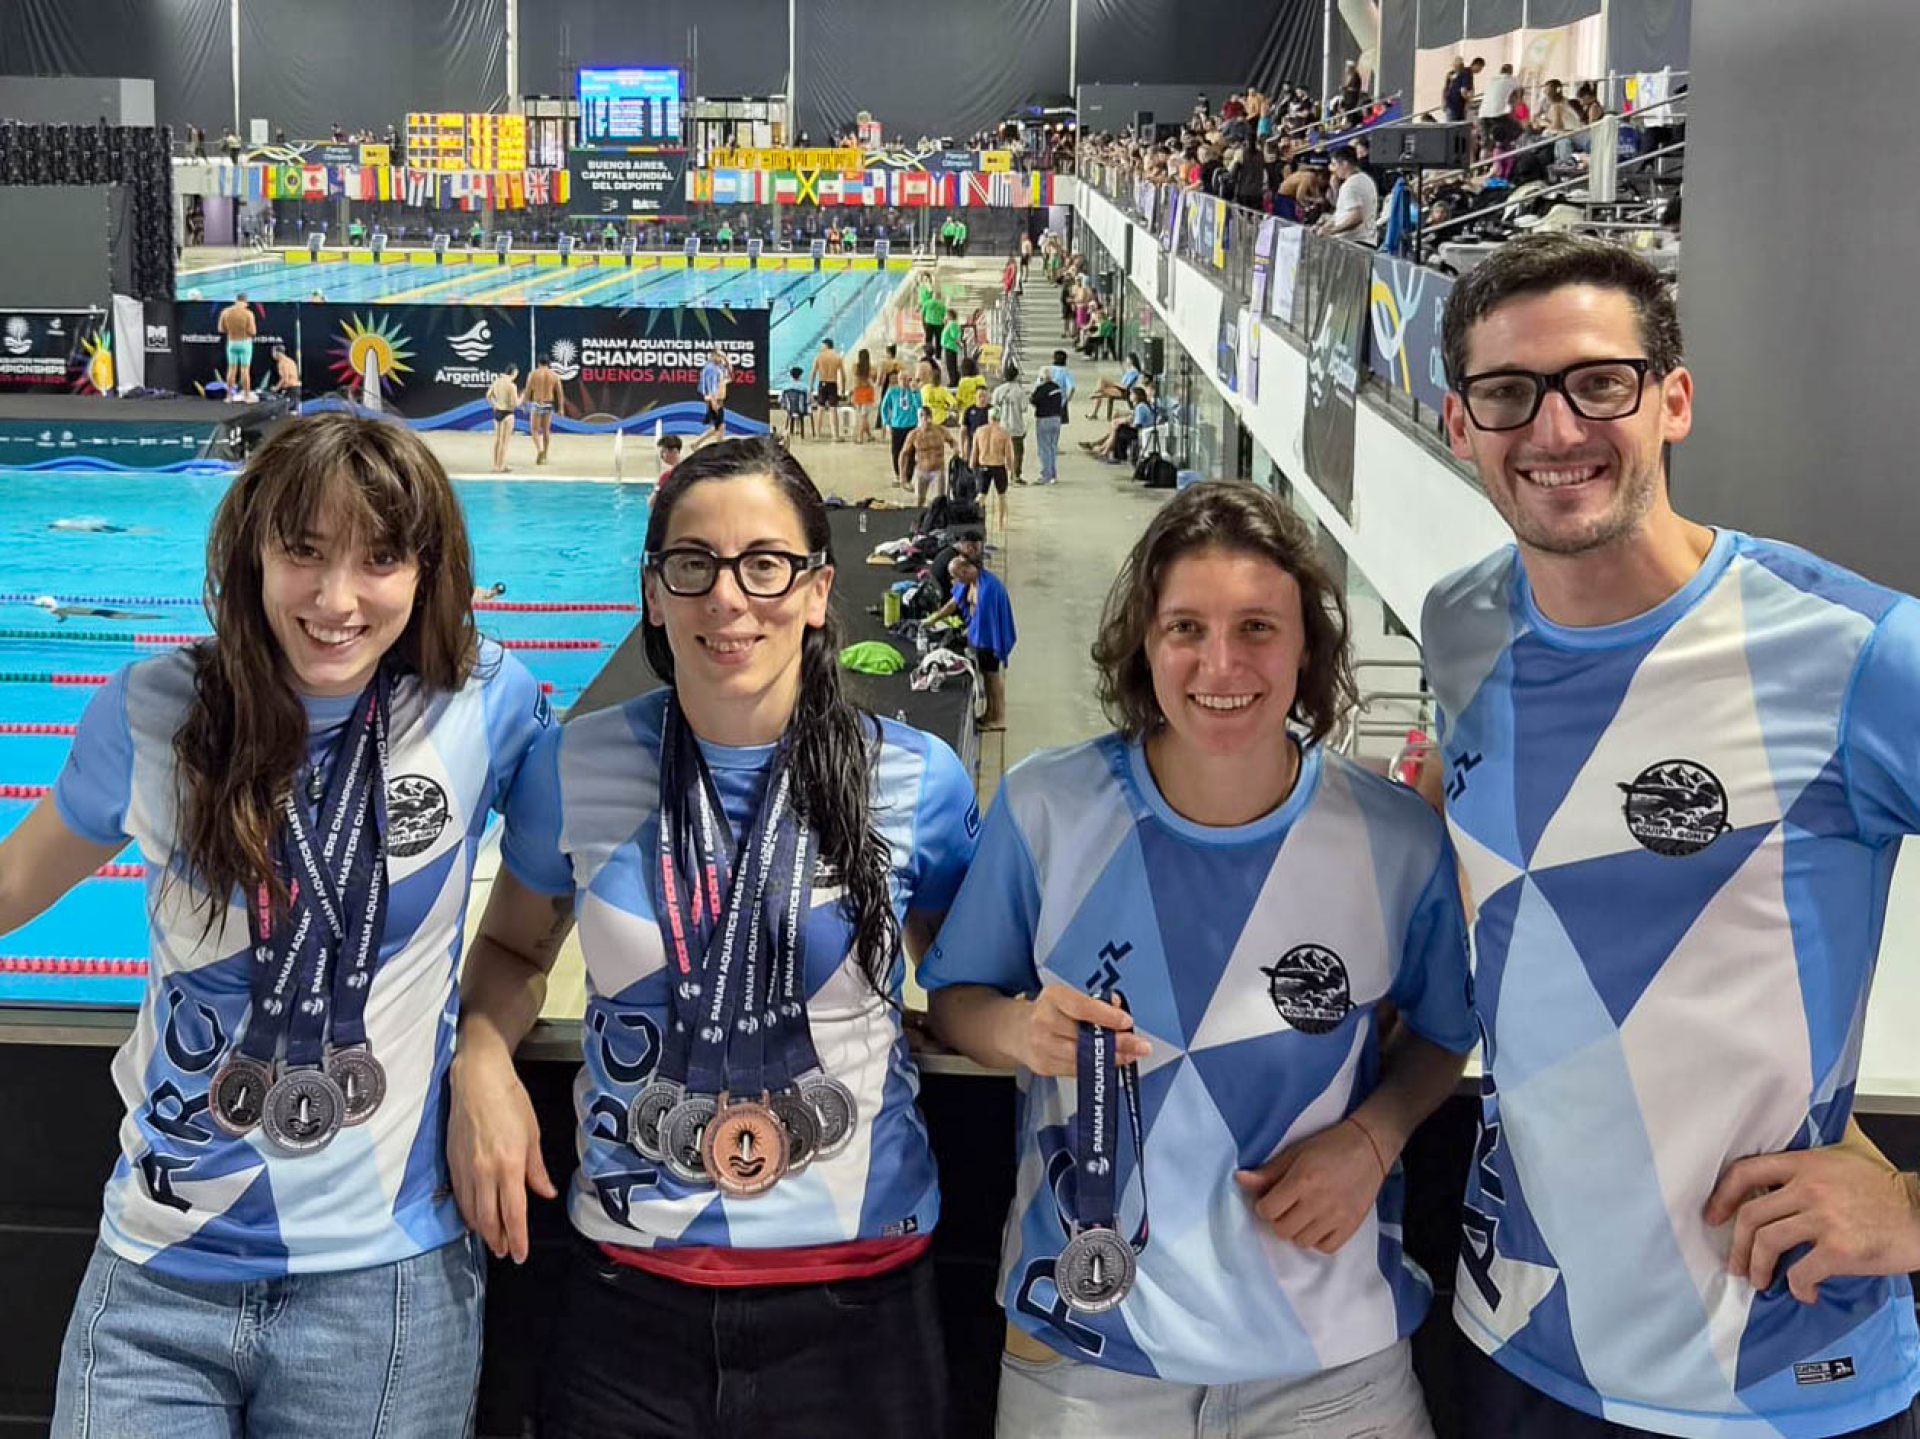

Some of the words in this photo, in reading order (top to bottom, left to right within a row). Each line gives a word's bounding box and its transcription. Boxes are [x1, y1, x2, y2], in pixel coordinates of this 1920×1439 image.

[581, 170, 624, 180] CAPITAL
[626, 171, 675, 181] MUNDIAL
[587, 160, 631, 170] BUENOS
[633, 161, 668, 171] AIRES,
[592, 180, 613, 190] DEL
[614, 180, 663, 190] DEPORTE
[581, 351, 755, 368] CHAMPIONSPS
[582, 338, 627, 348] PANAM
[630, 339, 692, 349] AQUATICS
[694, 340, 754, 350] MASTERS
[582, 368, 654, 382] BUENOS
[659, 369, 697, 383] AIRE
[298, 839, 327, 897] AQUATICS
[337, 827, 361, 886] MASTERS
[793, 836, 809, 889] MASTERS
[356, 923, 374, 969] PANAM
[365, 860, 384, 923] AQUATICS
[710, 974, 728, 1022] PANAM
[719, 909, 740, 975] AQUATICS
[731, 851, 751, 911] MASTERS
[747, 900, 763, 964] AQUATICS
[786, 888, 801, 949] AQUATICS
[273, 949, 298, 995] PANAM
[744, 964, 757, 1012] PANAM
[784, 949, 795, 997] PANAM
[1094, 1037, 1105, 1109] AQUATICS
[1093, 1109, 1105, 1153] PANAM
